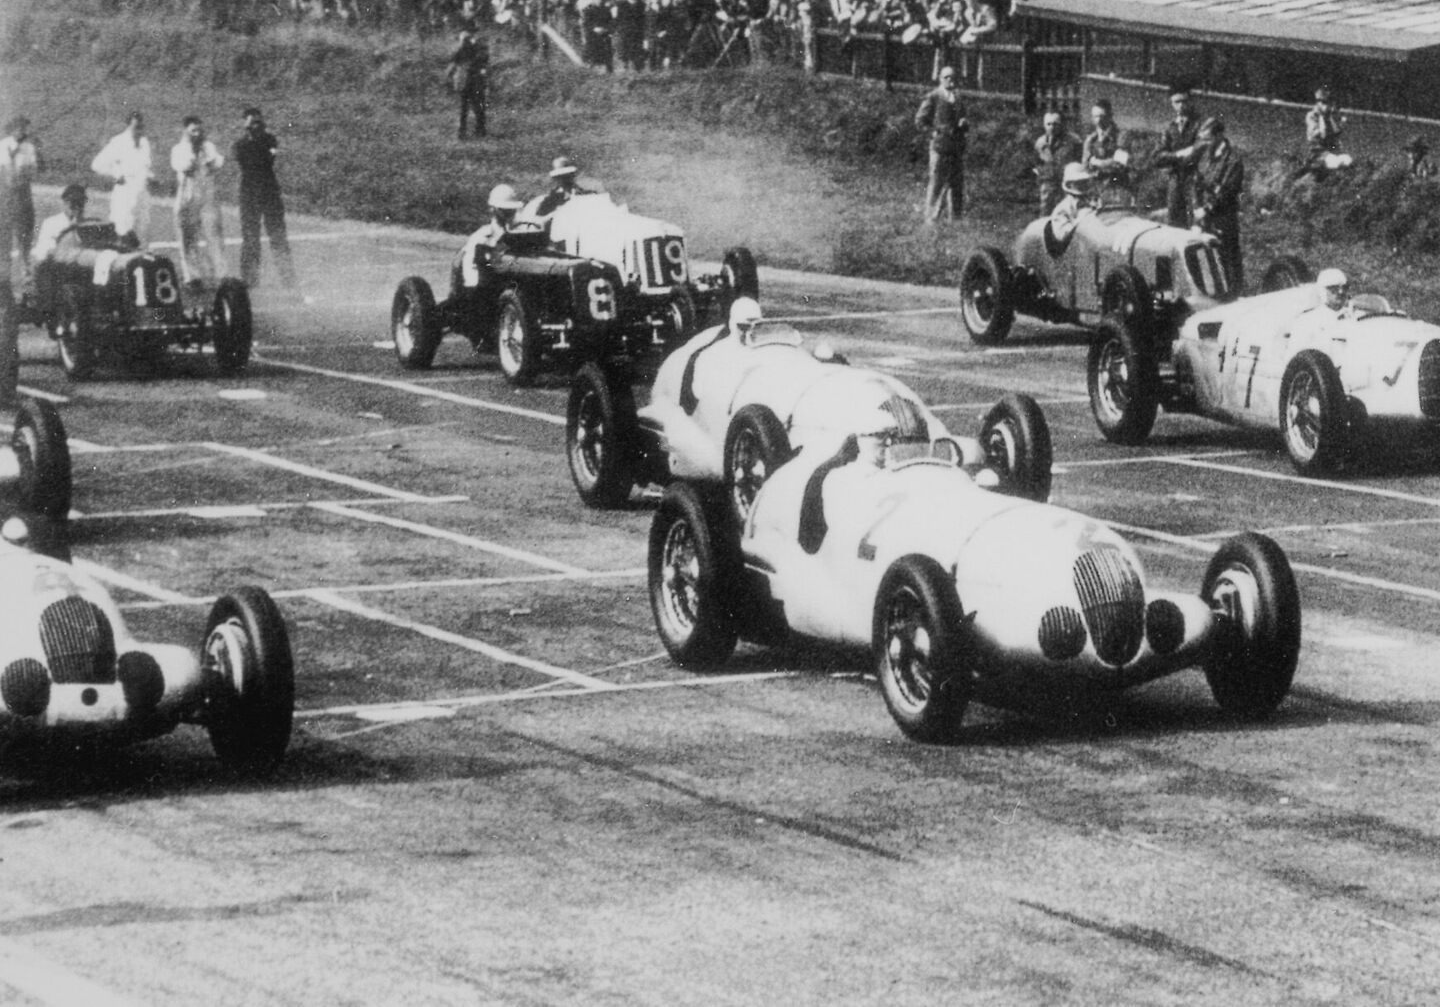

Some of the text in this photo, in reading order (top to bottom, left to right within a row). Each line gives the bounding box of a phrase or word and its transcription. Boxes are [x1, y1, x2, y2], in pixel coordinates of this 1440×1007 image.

[651, 239, 688, 285] 19
[133, 266, 177, 307] 18
[857, 493, 908, 561] 2
